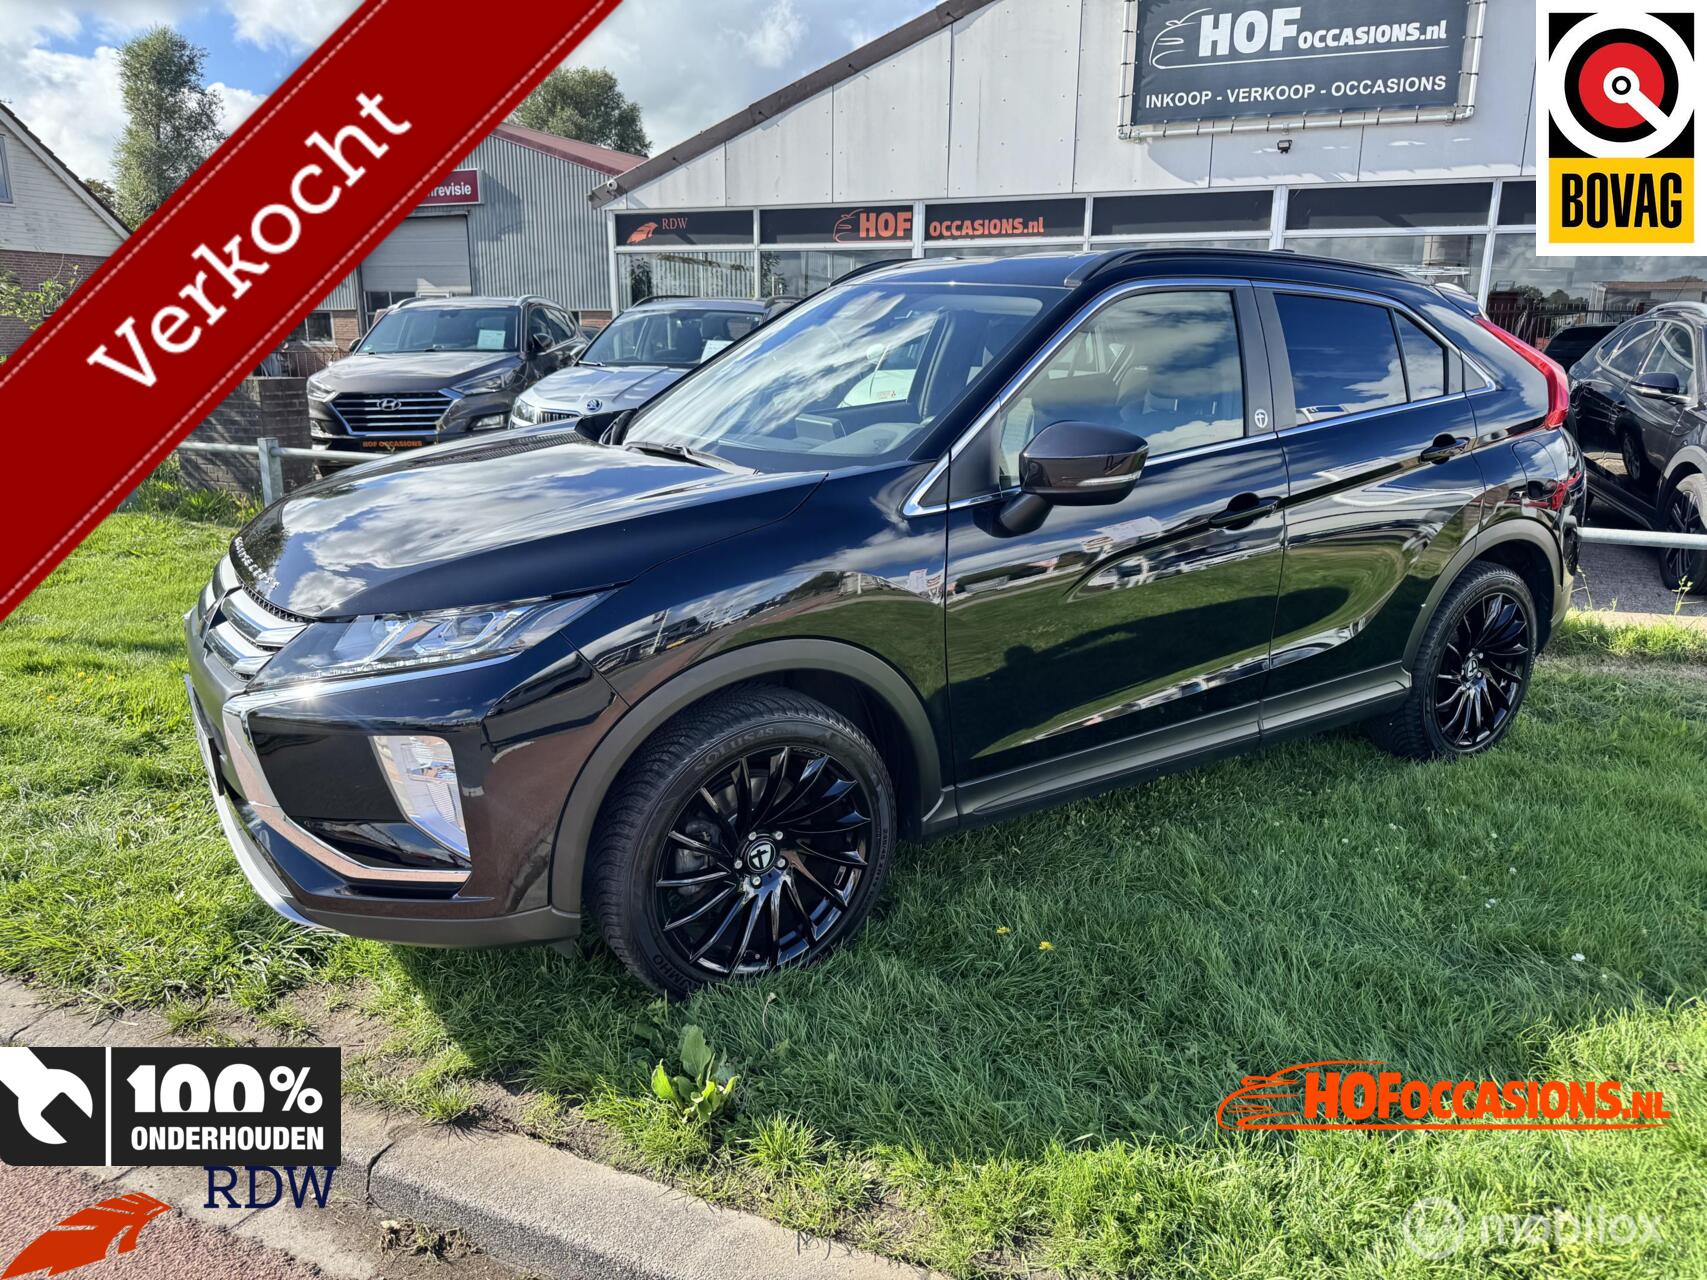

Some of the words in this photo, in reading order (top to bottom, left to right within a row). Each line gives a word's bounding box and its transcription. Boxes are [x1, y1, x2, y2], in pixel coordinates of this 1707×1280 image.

[1145, 88, 1213, 109] INKOOP
[1227, 84, 1316, 104] VERKOOP
[1331, 75, 1447, 97] OCCASIONS
[662, 217, 688, 230] RDW
[859, 212, 913, 239] HOF
[929, 217, 1044, 237] OCCASIONS.nl
